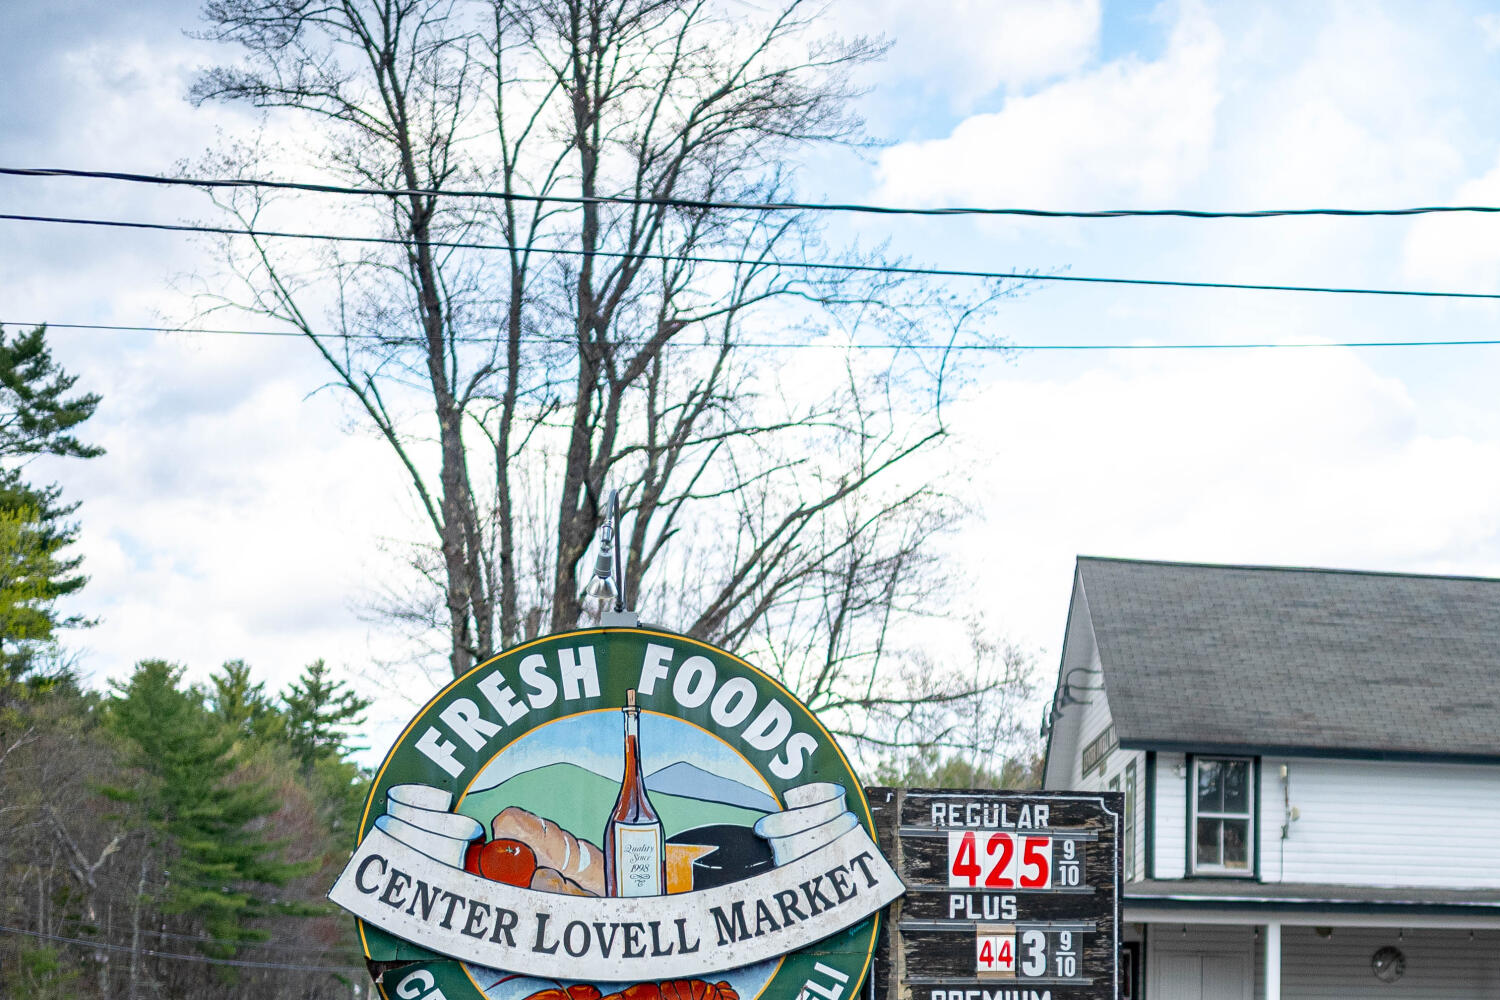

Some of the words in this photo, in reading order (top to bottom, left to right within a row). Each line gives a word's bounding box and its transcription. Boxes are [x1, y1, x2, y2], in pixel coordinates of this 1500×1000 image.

[415, 645, 601, 779] FRESH
[637, 643, 819, 780] FOODS
[931, 802, 1050, 829] REGULAR
[624, 843, 655, 853] Quality
[952, 831, 1050, 889] 425
[355, 853, 517, 947] CENTER
[532, 912, 701, 958] LOVELL
[709, 851, 880, 946] MARKET
[950, 894, 1017, 920] PLUS
